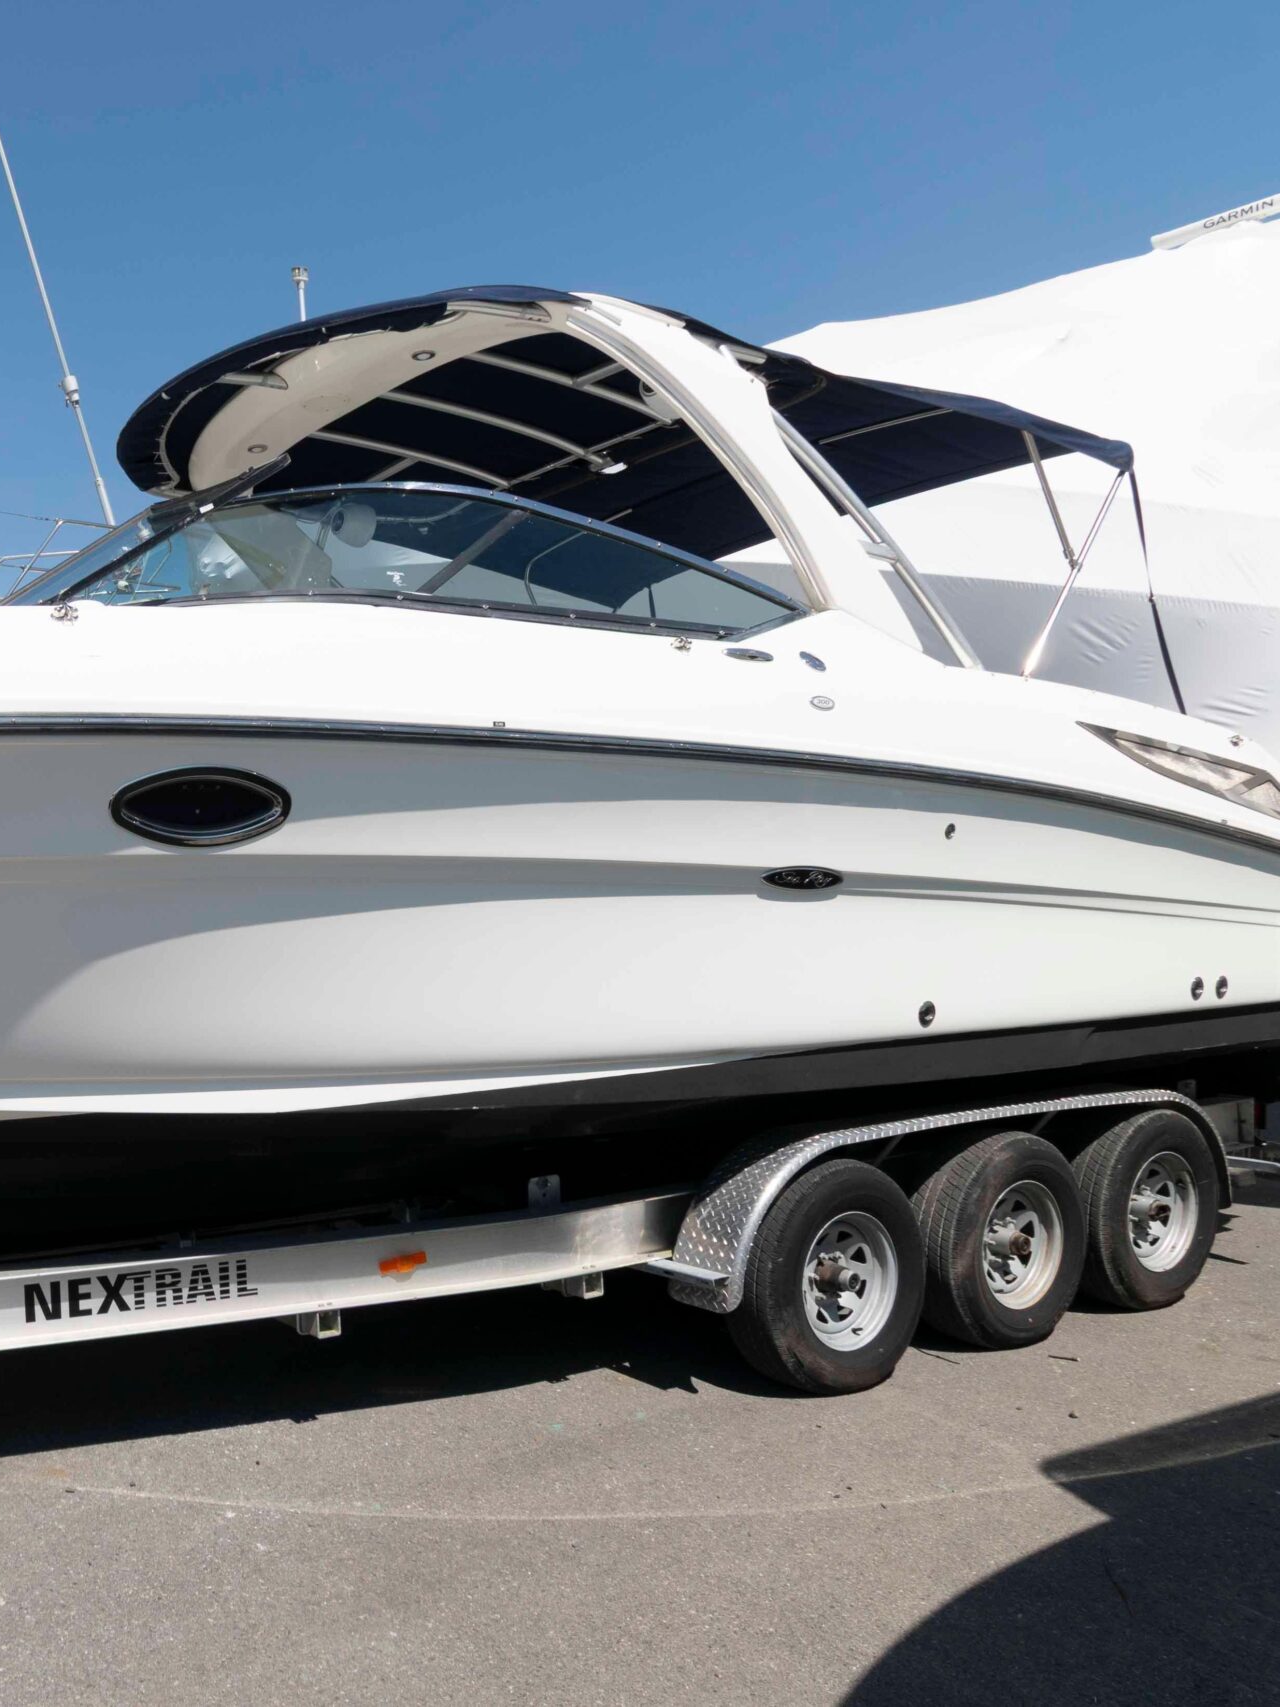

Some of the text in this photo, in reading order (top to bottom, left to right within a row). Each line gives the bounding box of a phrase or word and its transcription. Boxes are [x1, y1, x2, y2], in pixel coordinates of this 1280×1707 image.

[1203, 199, 1274, 229] GARMIN
[774, 871, 801, 884] Sea
[23, 1259, 259, 1323] NEXTRAIL
